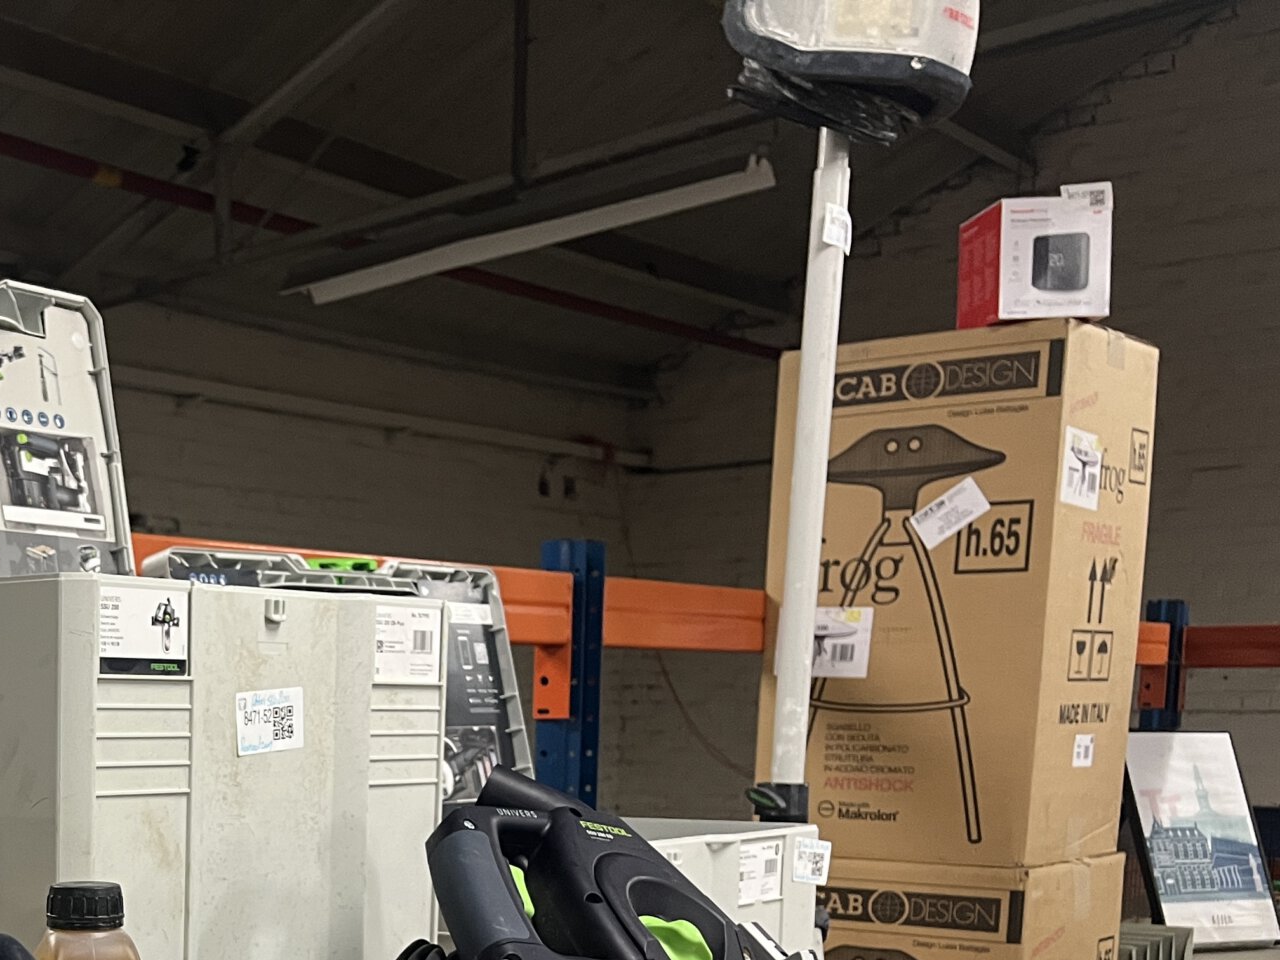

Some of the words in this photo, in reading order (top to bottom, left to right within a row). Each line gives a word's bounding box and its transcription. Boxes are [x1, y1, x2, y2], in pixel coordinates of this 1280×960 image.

[835, 373, 897, 401] CAB
[944, 358, 1036, 390] DESIGN
[965, 517, 1021, 557] h.65
[1081, 521, 1122, 545] FRAGILE
[819, 536, 904, 605] rog
[243, 708, 272, 726] 8471-52
[1059, 703, 1080, 725] MADE
[1081, 703, 1089, 724] IN
[1090, 702, 1111, 724] ITALY
[824, 776, 914, 792] ANTISHOCK
[496, 807, 538, 819] UNIVERS
[579, 820, 632, 837] FESTOOL
[817, 892, 864, 916] AB
[909, 898, 996, 927] DESIGN
